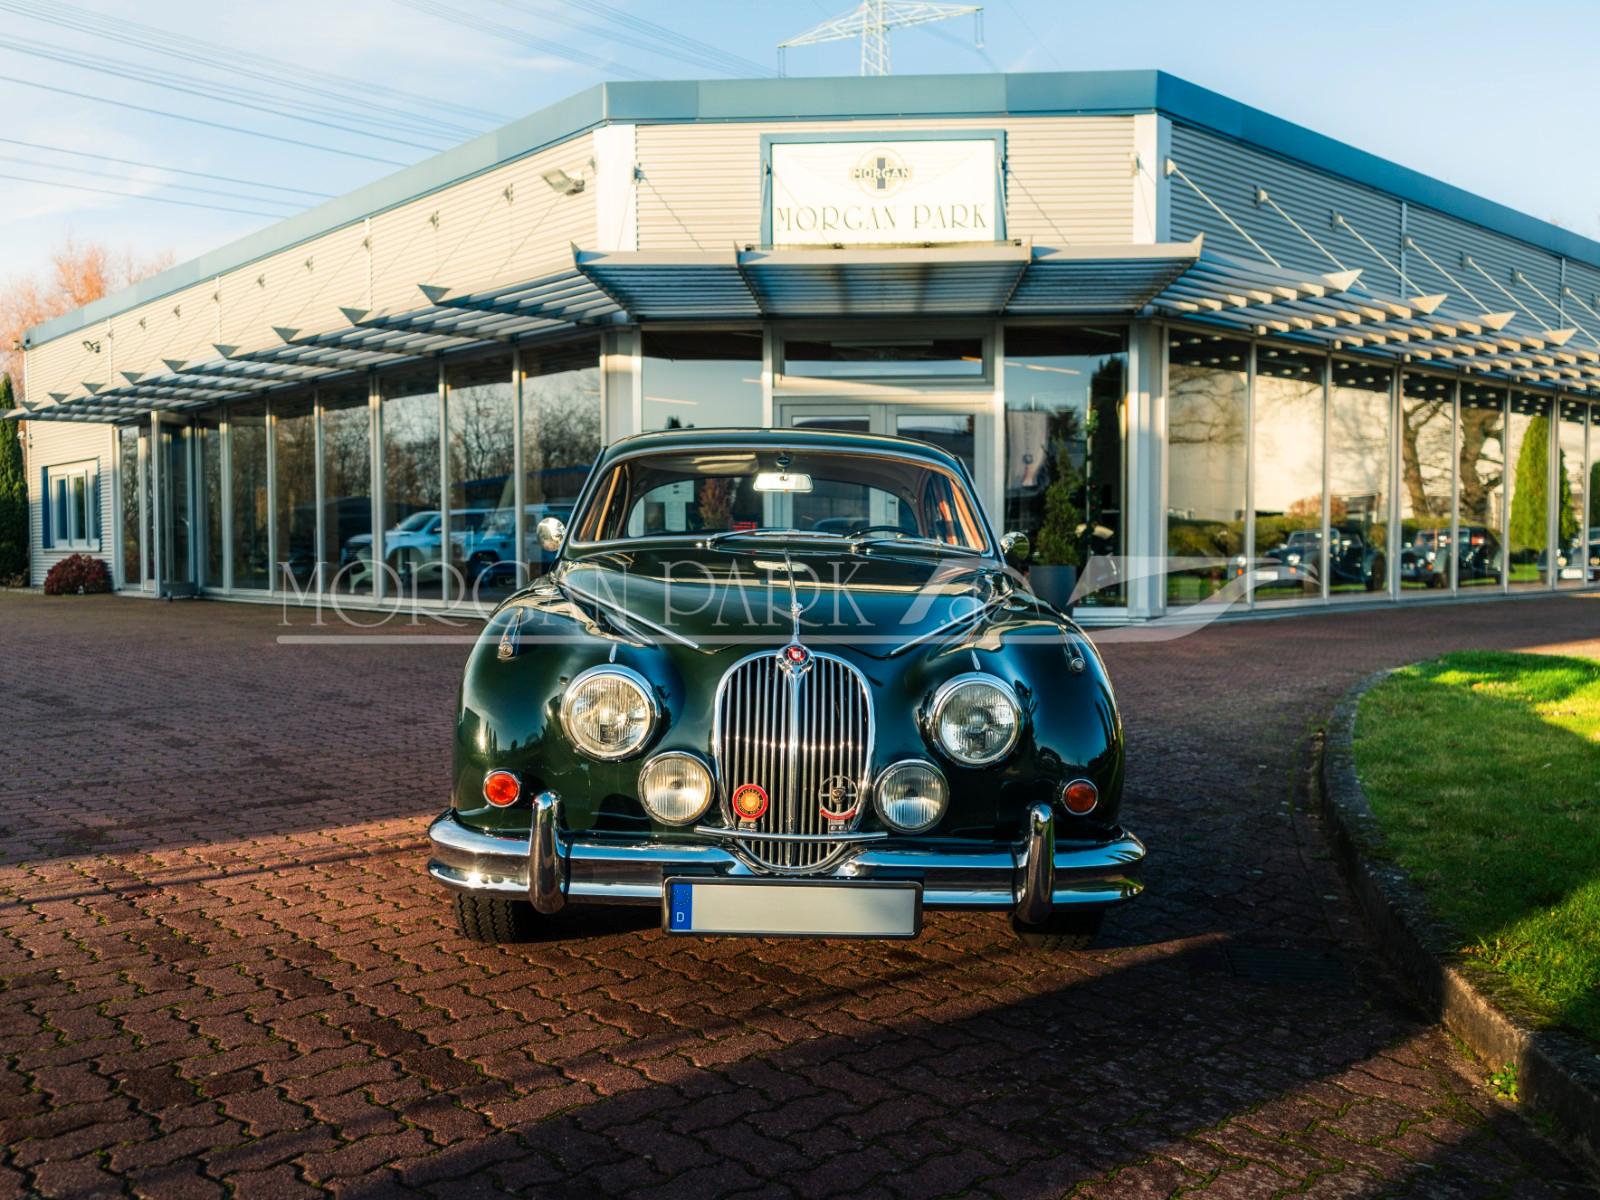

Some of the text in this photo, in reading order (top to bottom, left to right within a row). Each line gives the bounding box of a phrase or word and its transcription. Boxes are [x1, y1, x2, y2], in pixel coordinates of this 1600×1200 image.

[853, 167, 910, 178] MORGAN
[776, 204, 988, 231] MORGAN PARK
[676, 911, 685, 923] D
